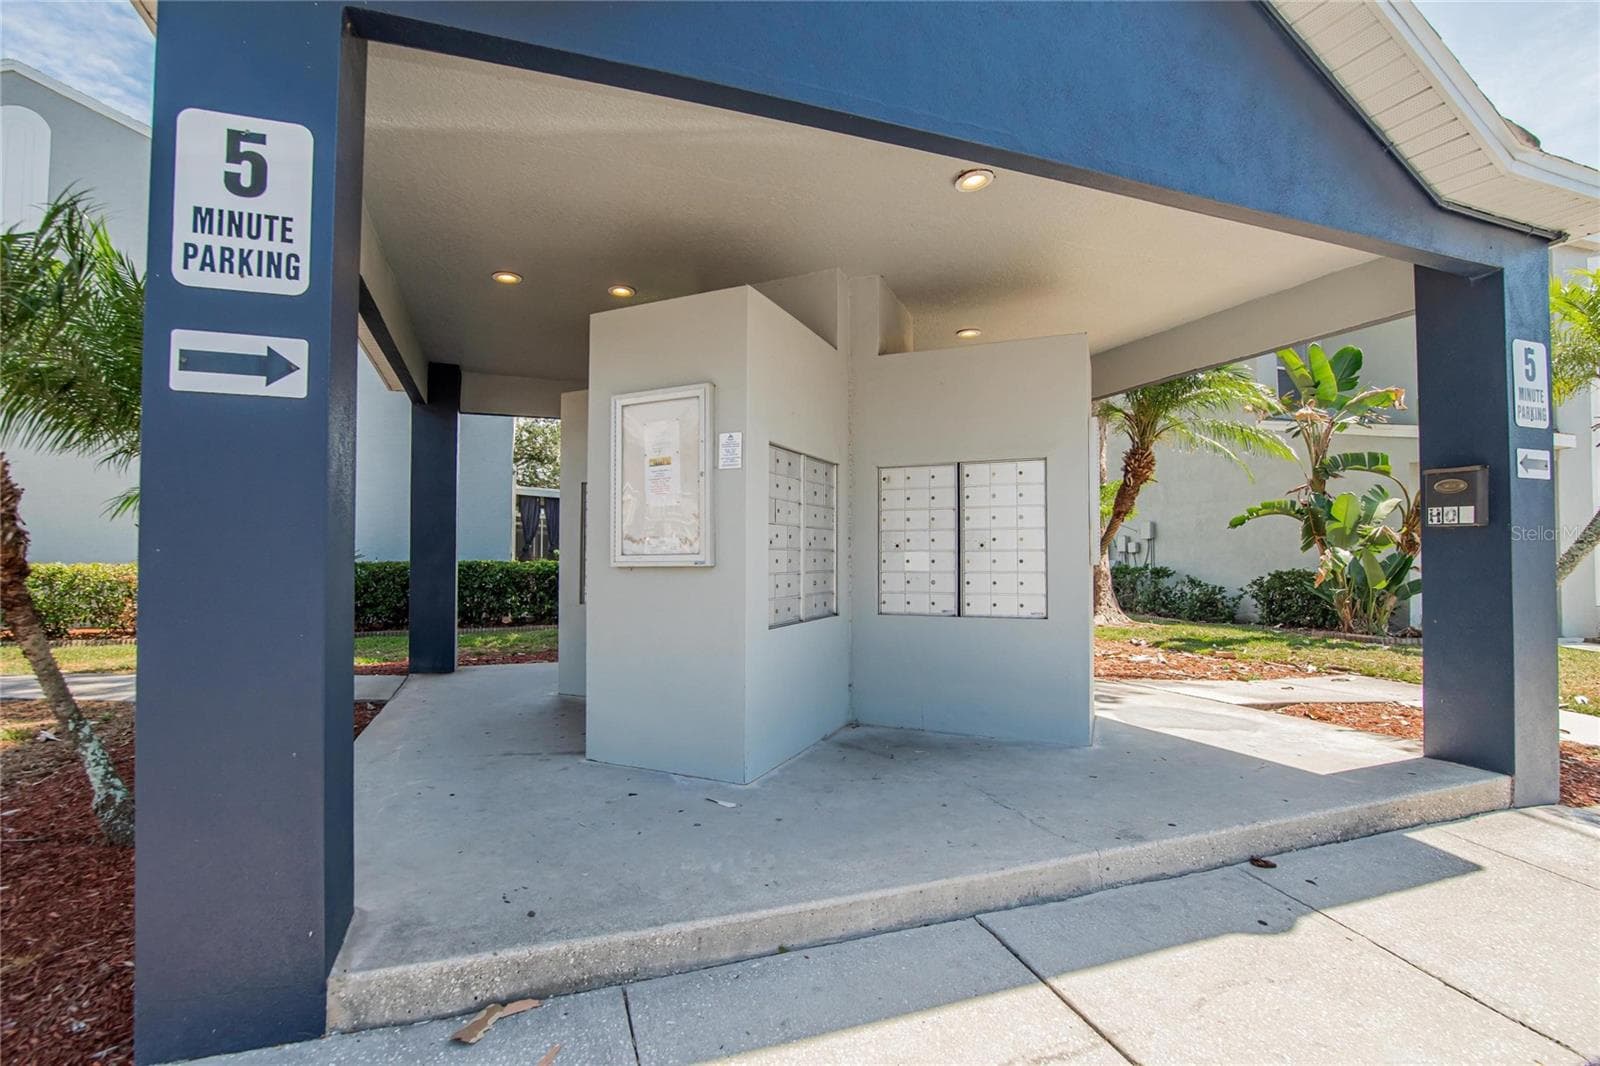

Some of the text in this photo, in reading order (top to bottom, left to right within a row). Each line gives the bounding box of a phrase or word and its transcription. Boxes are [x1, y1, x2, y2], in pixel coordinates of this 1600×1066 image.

[224, 128, 268, 198] 5
[192, 206, 294, 243] MINUTE
[182, 242, 300, 280] PARKING
[1524, 347, 1536, 382] 5
[1517, 404, 1547, 422] PARKING
[1518, 387, 1544, 403] MINUTE
